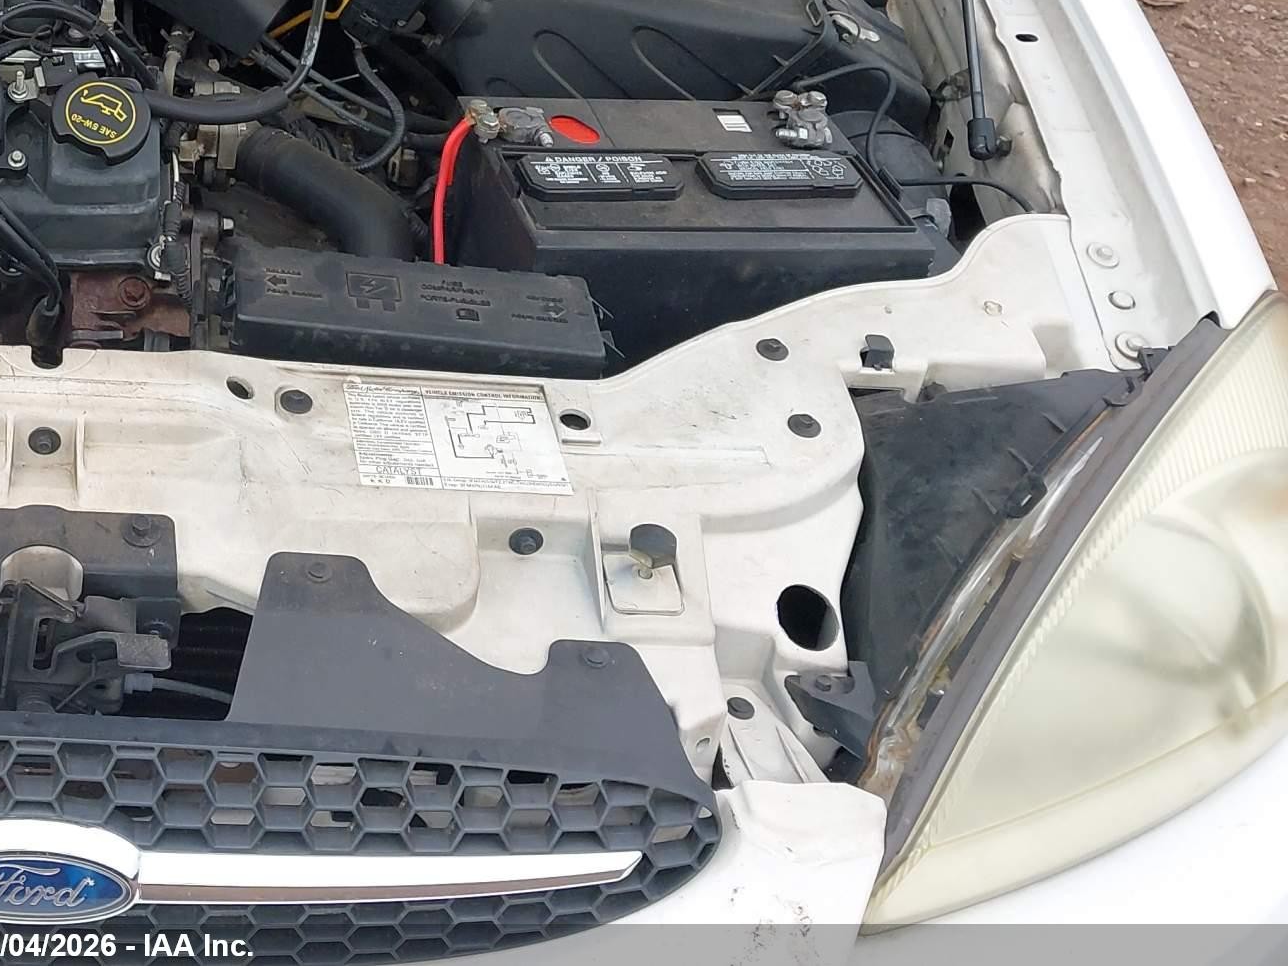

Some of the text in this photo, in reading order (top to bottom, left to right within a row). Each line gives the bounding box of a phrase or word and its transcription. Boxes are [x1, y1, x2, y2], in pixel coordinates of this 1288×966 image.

[71, 113, 118, 139] SAE 5W-20
[375, 465, 421, 476] CATALYST
